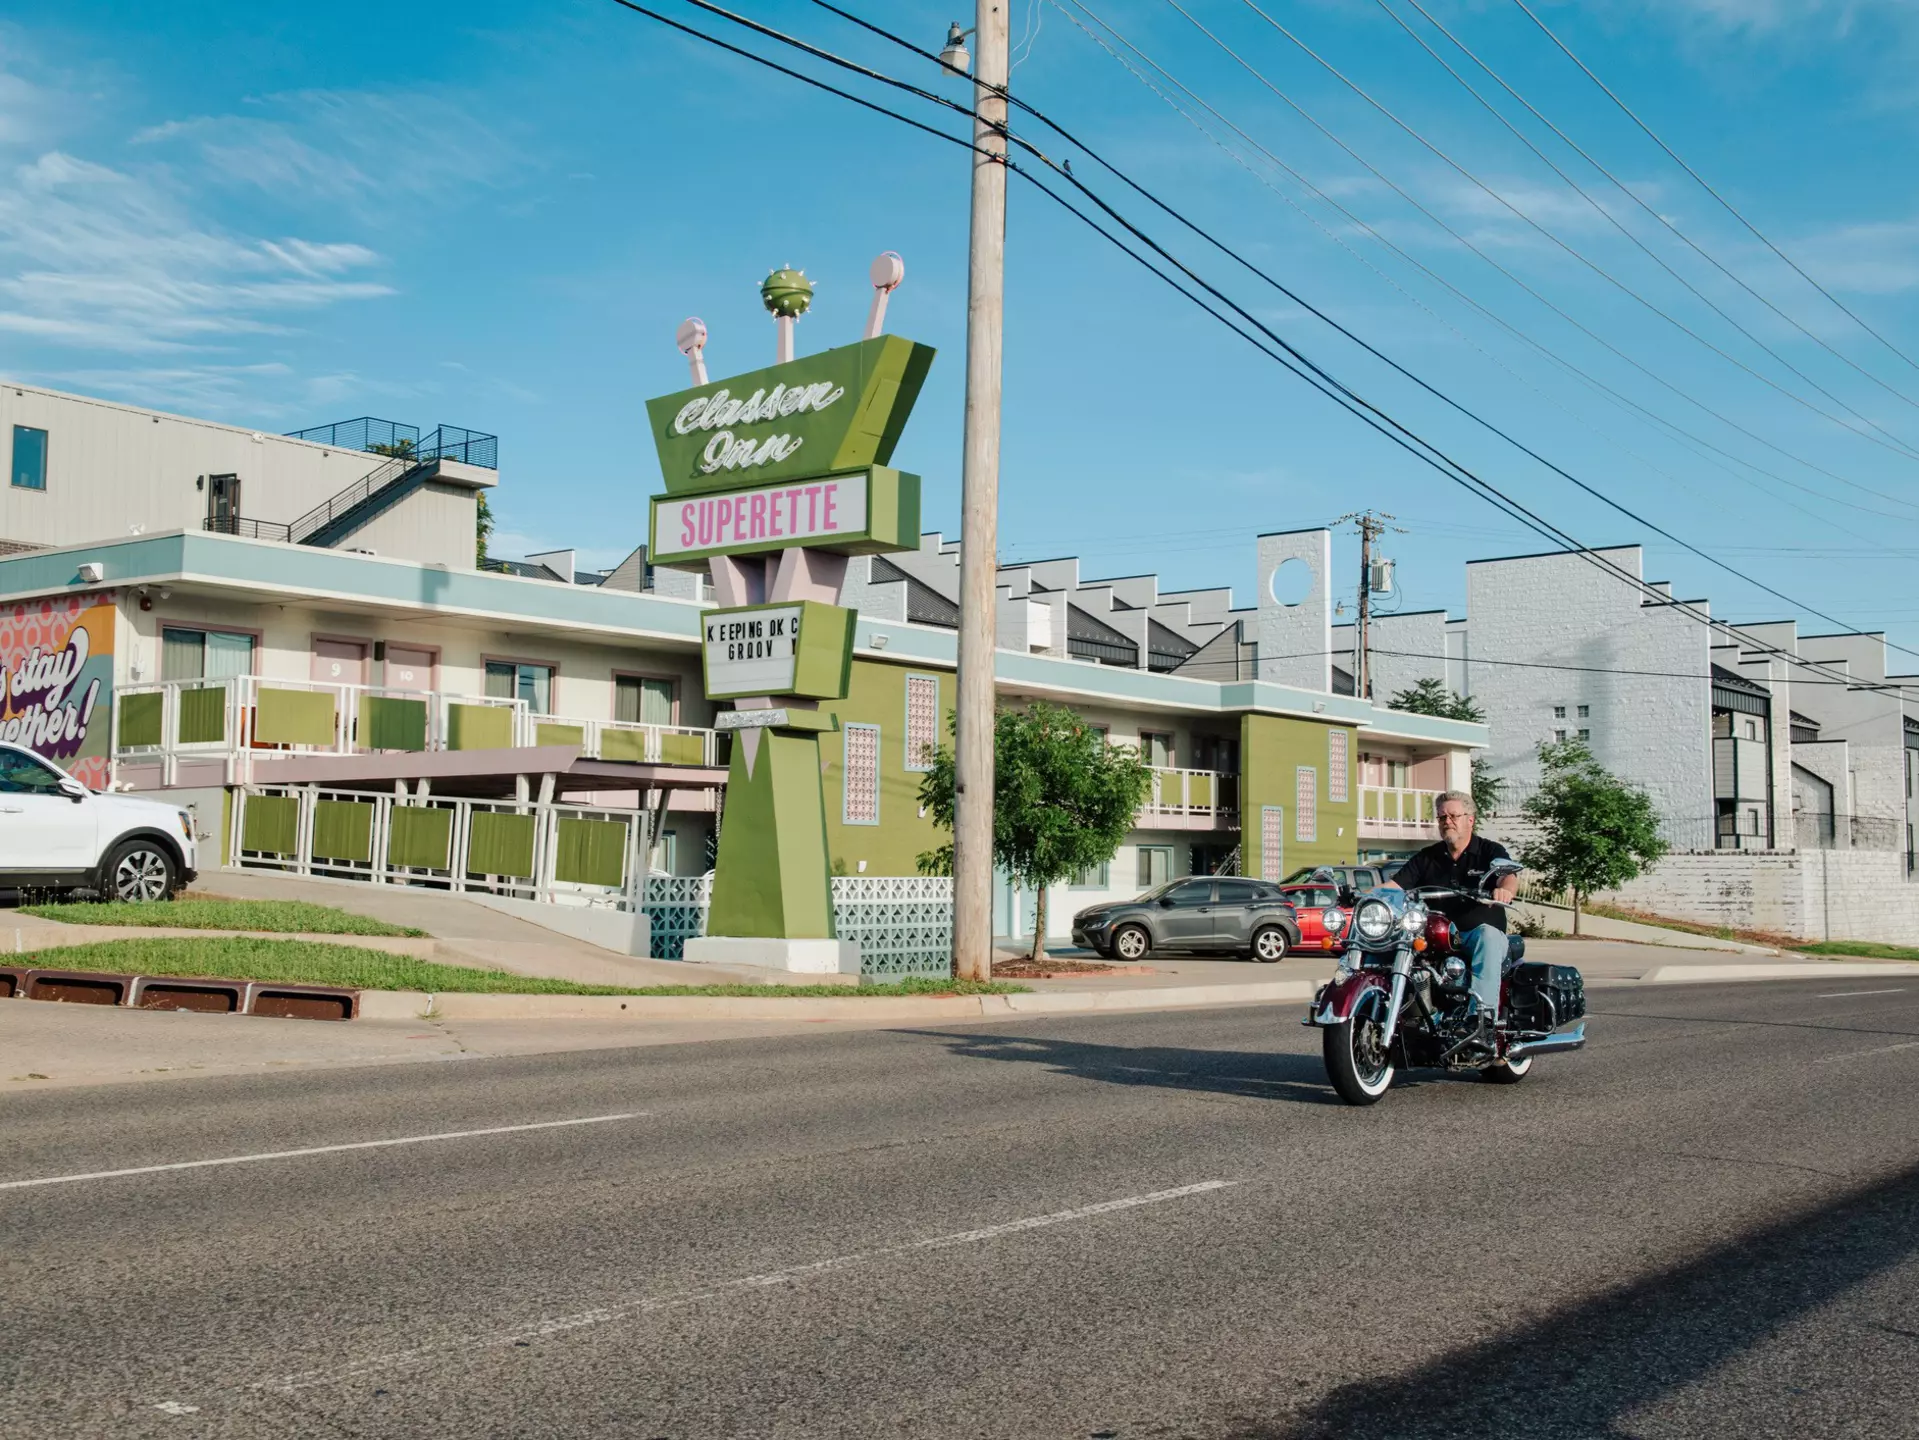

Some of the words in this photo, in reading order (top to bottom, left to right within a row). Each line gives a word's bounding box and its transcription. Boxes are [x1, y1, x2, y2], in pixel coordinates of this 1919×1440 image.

[674, 381, 845, 435] Classen
[700, 430, 804, 474] Inn
[680, 484, 838, 548] SUPERETTE
[10, 625, 90, 712] stay
[330, 663, 342, 678] 9
[400, 670, 414, 682] 10
